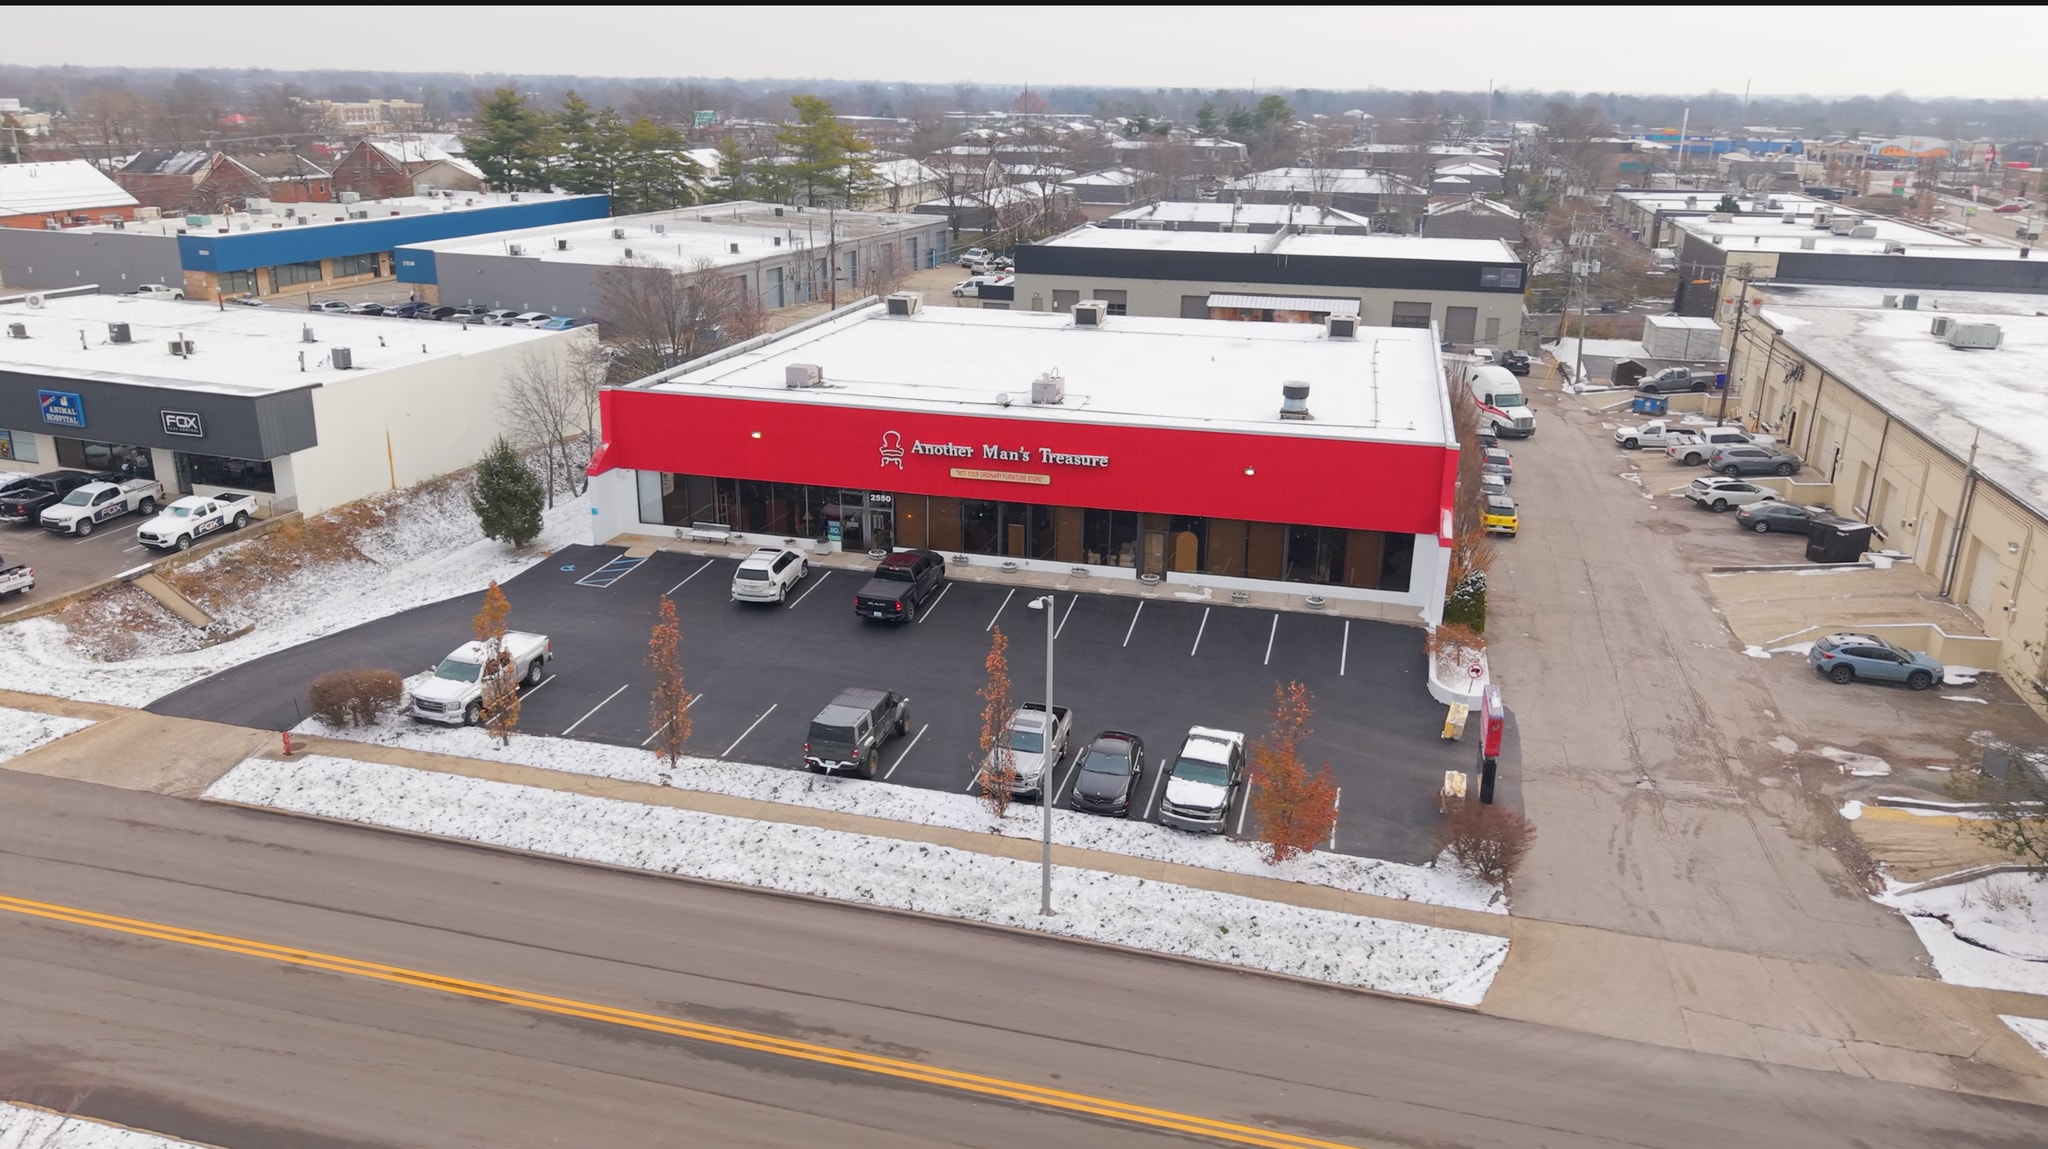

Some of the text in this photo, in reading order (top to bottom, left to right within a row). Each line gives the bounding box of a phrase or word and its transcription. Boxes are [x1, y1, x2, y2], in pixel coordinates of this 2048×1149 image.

[49, 406, 77, 416] ANIMAL
[46, 413, 79, 424] HOSPITAL
[165, 414, 199, 429] FOX
[911, 439, 1109, 468] Another Man's Treasure
[870, 493, 892, 502] 2550
[101, 503, 122, 517] FOX
[198, 518, 219, 533] FOX
